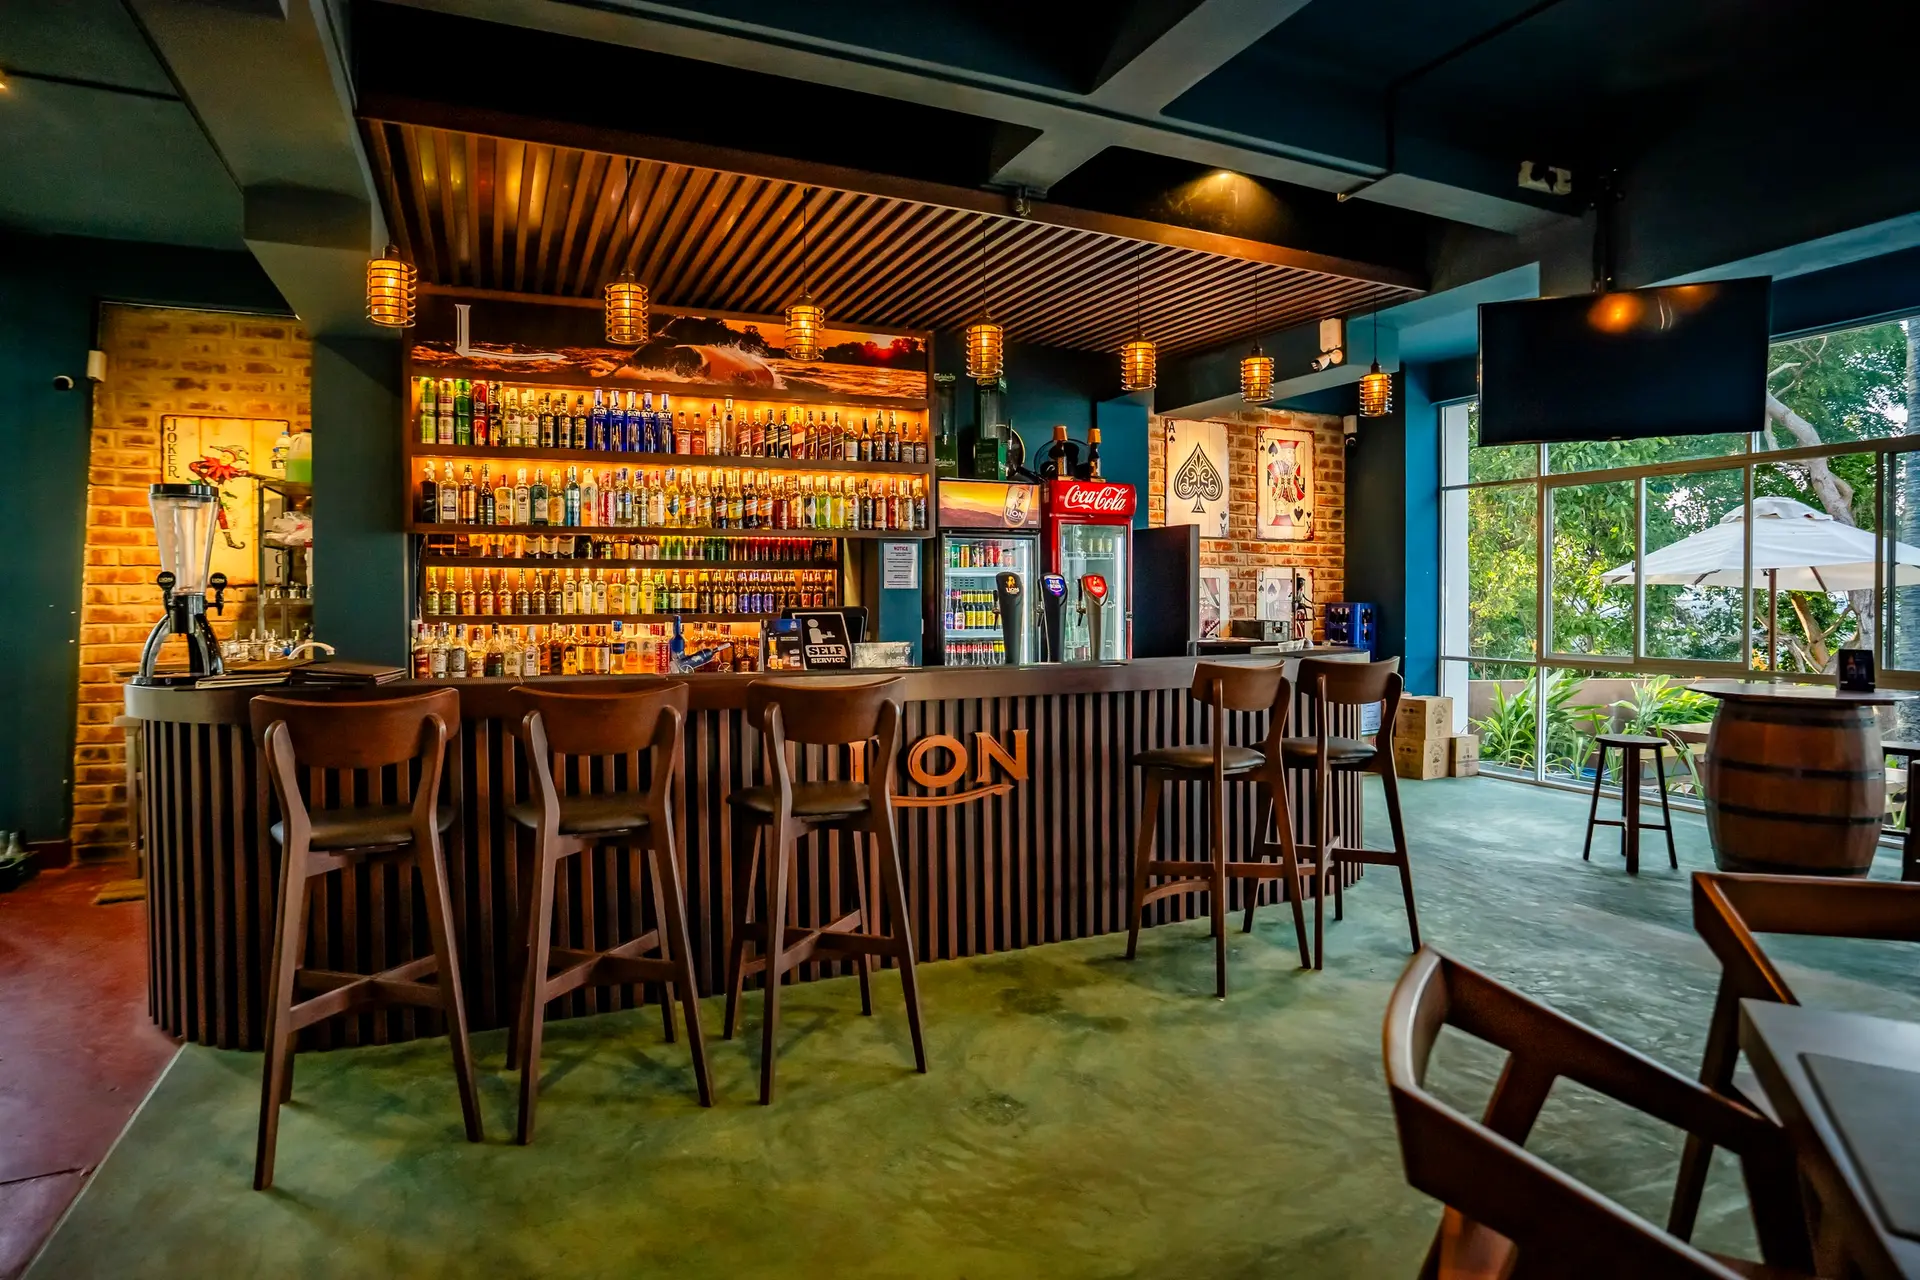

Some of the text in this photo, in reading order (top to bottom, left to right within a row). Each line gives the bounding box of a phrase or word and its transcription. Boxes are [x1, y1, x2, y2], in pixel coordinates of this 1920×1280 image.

[1168, 421, 1176, 433] A
[1259, 430, 1265, 443] K
[167, 418, 180, 478] JOKER
[1063, 484, 1129, 511] Coca-Cola
[1006, 508, 1025, 519] LION
[1259, 570, 1264, 582] J
[808, 646, 842, 656] SELF
